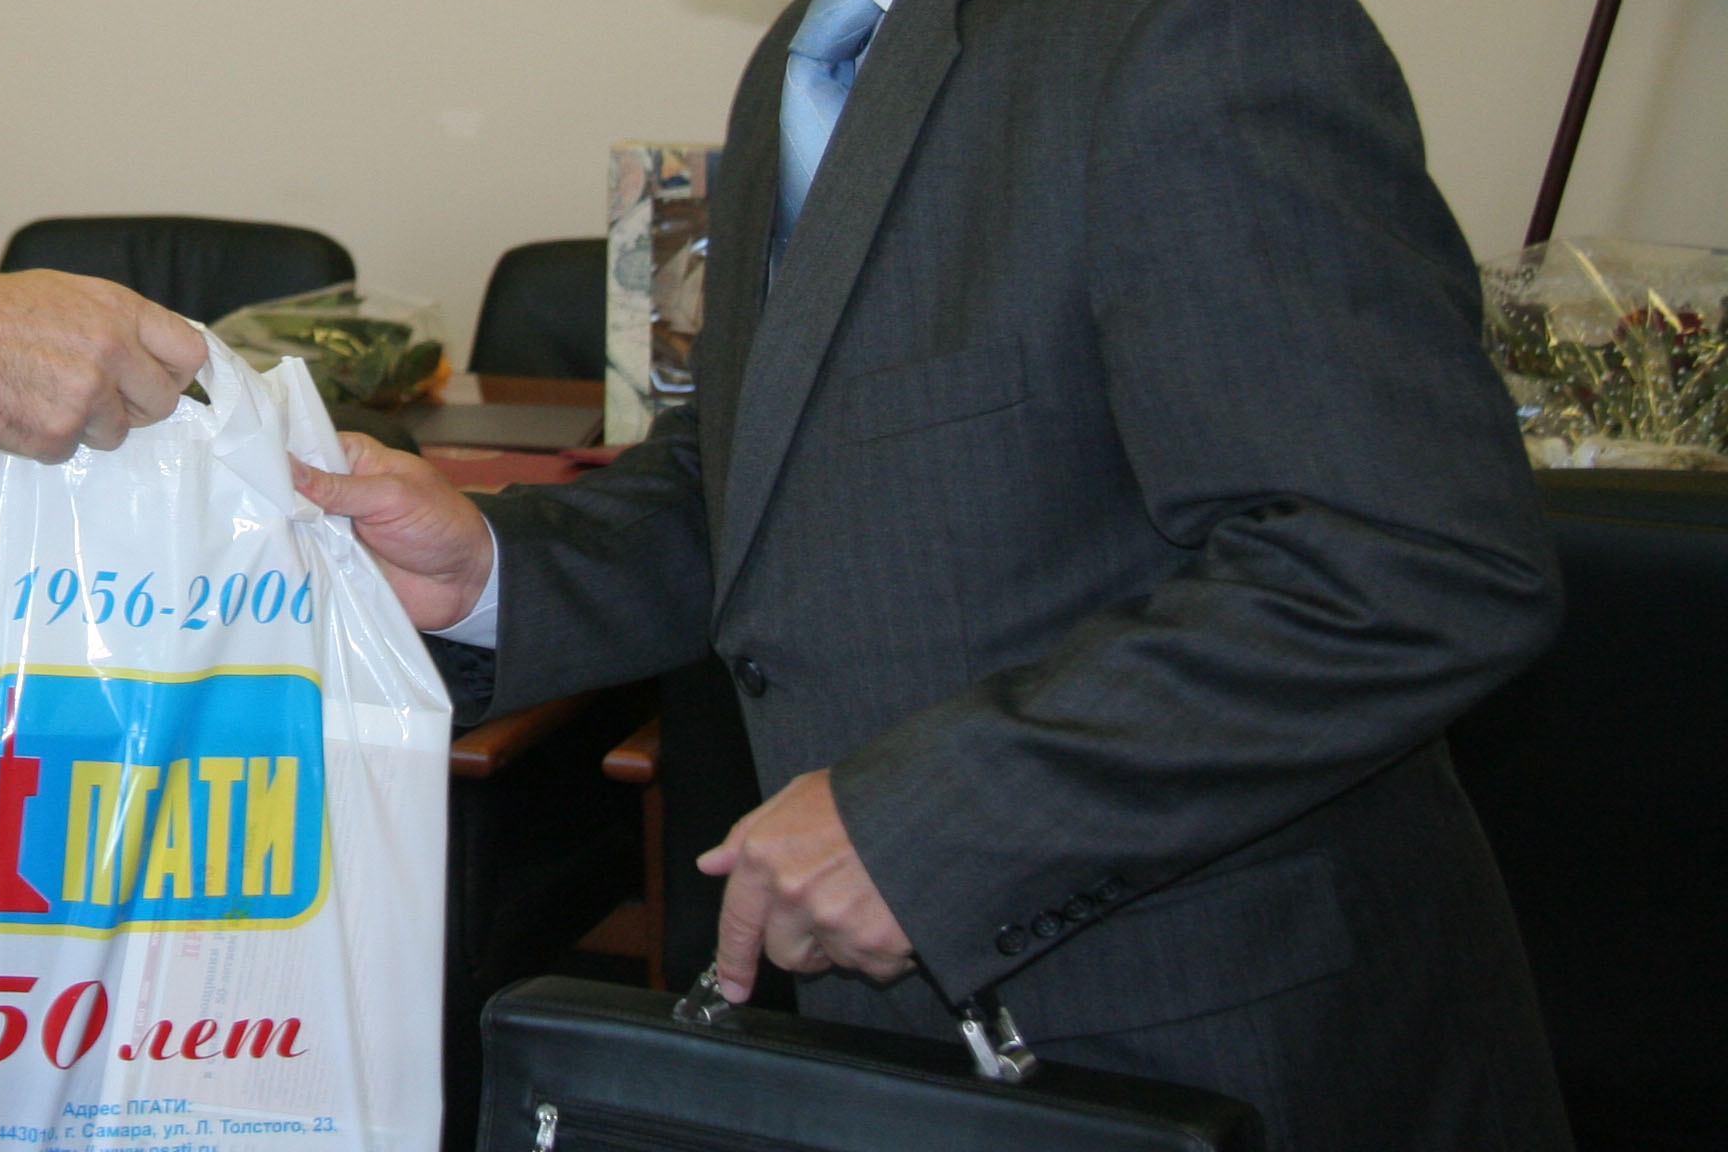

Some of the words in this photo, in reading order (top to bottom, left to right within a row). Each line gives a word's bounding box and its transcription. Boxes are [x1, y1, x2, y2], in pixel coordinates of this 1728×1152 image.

[12, 566, 314, 630] 1956-2006
[61, 756, 300, 906] ПГАТИ
[118, 1017, 310, 1061] лет
[63, 1101, 122, 1119] Адрес
[127, 1098, 193, 1115] ПГАТИ:
[65, 1127, 77, 1139] г.
[81, 1123, 157, 1140] Самара,
[163, 1123, 191, 1139] ул.
[195, 1119, 213, 1135] Л.
[220, 1118, 307, 1135] Толстого,
[312, 1116, 338, 1133] 23.
